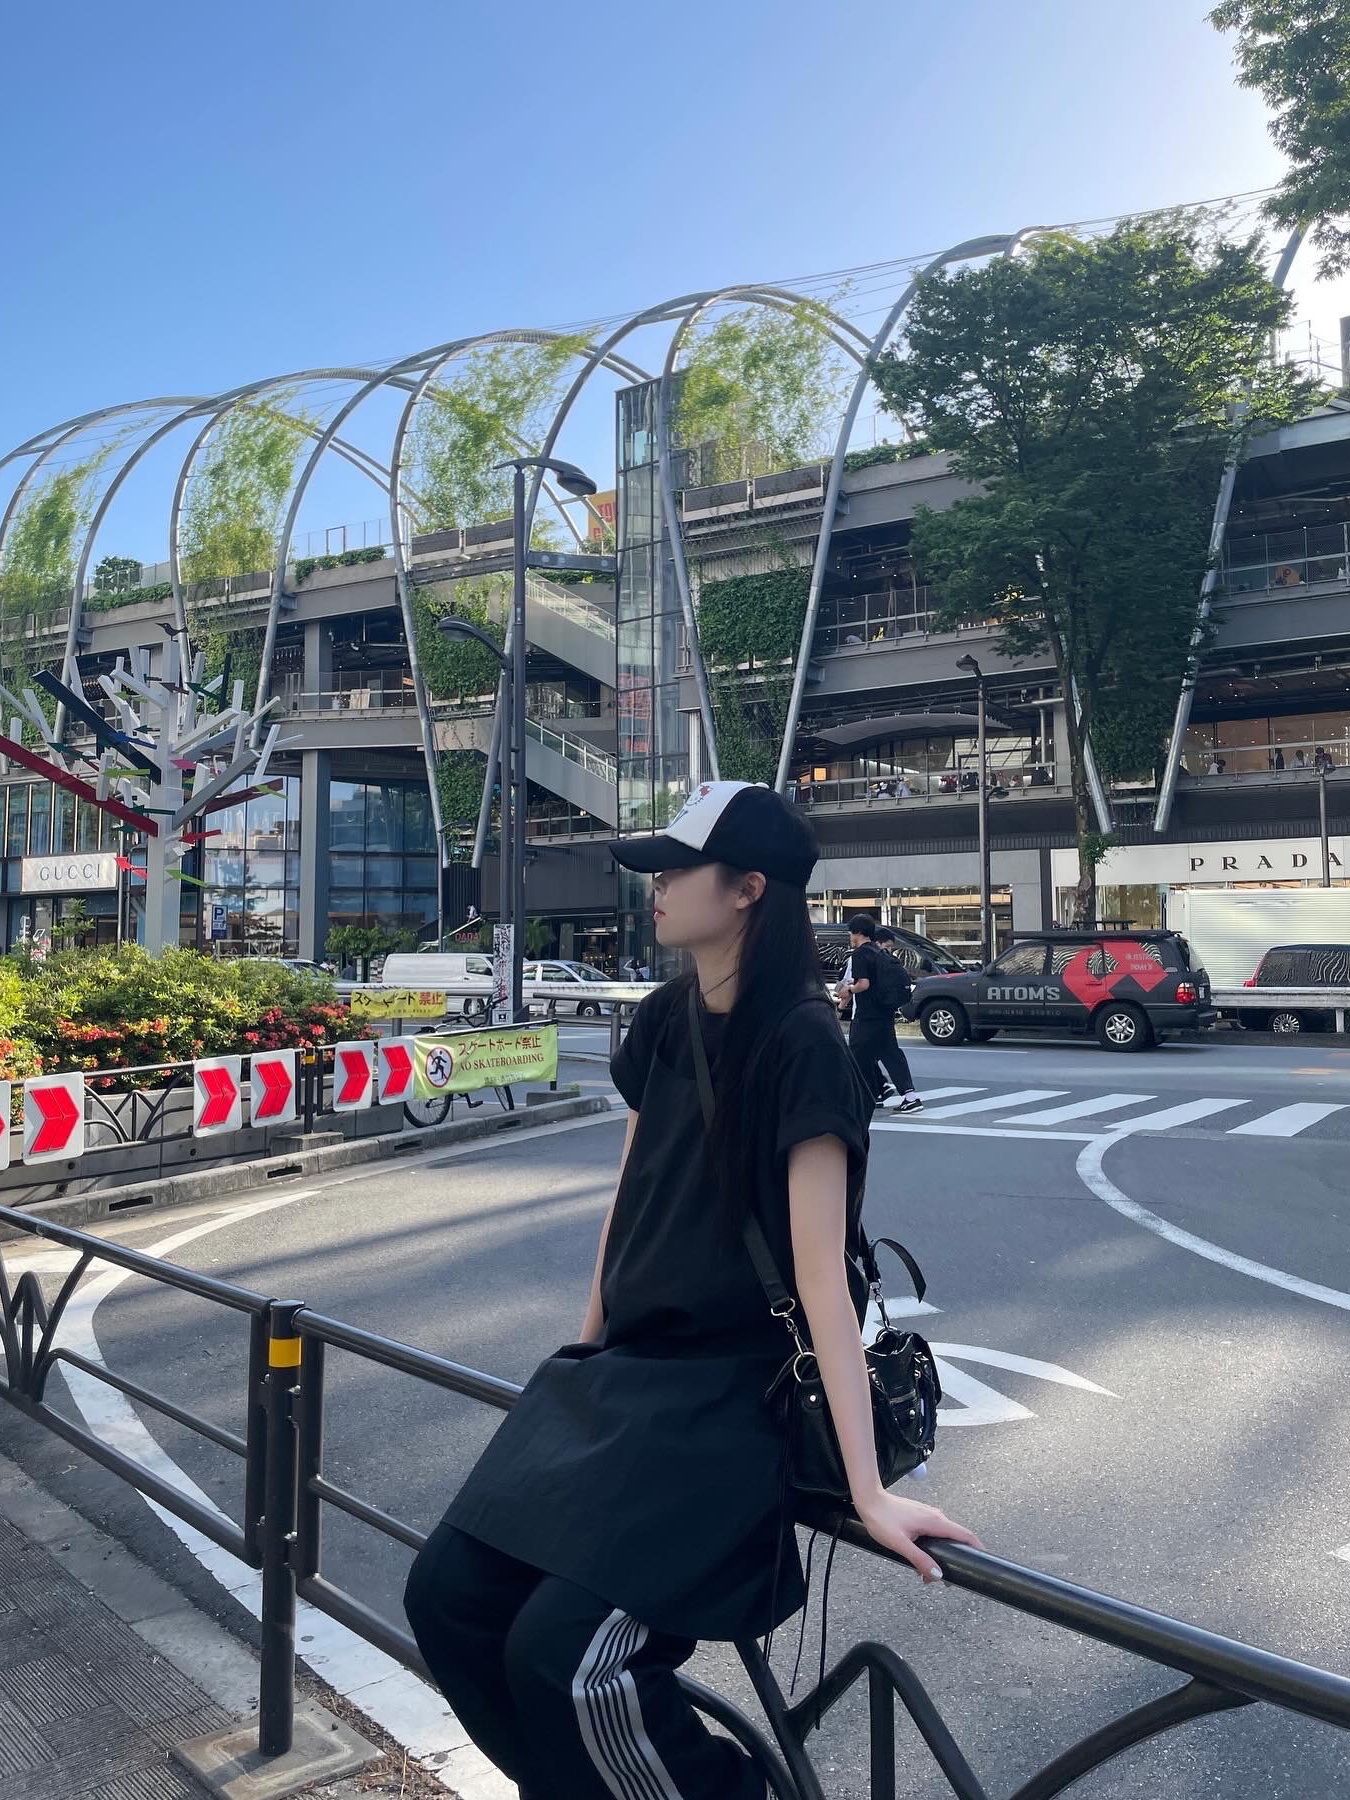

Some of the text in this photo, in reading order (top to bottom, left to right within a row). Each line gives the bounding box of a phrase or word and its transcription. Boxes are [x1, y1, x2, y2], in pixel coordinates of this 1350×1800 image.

[1190, 852, 1342, 871] PRADA
[40, 863, 100, 881] GUCCI
[214, 907, 224, 920] P
[987, 985, 1060, 1001] ATOM'S
[458, 1034, 542, 1057] スケートボード禁止
[459, 1053, 545, 1072] NO SKATEBOARDING
